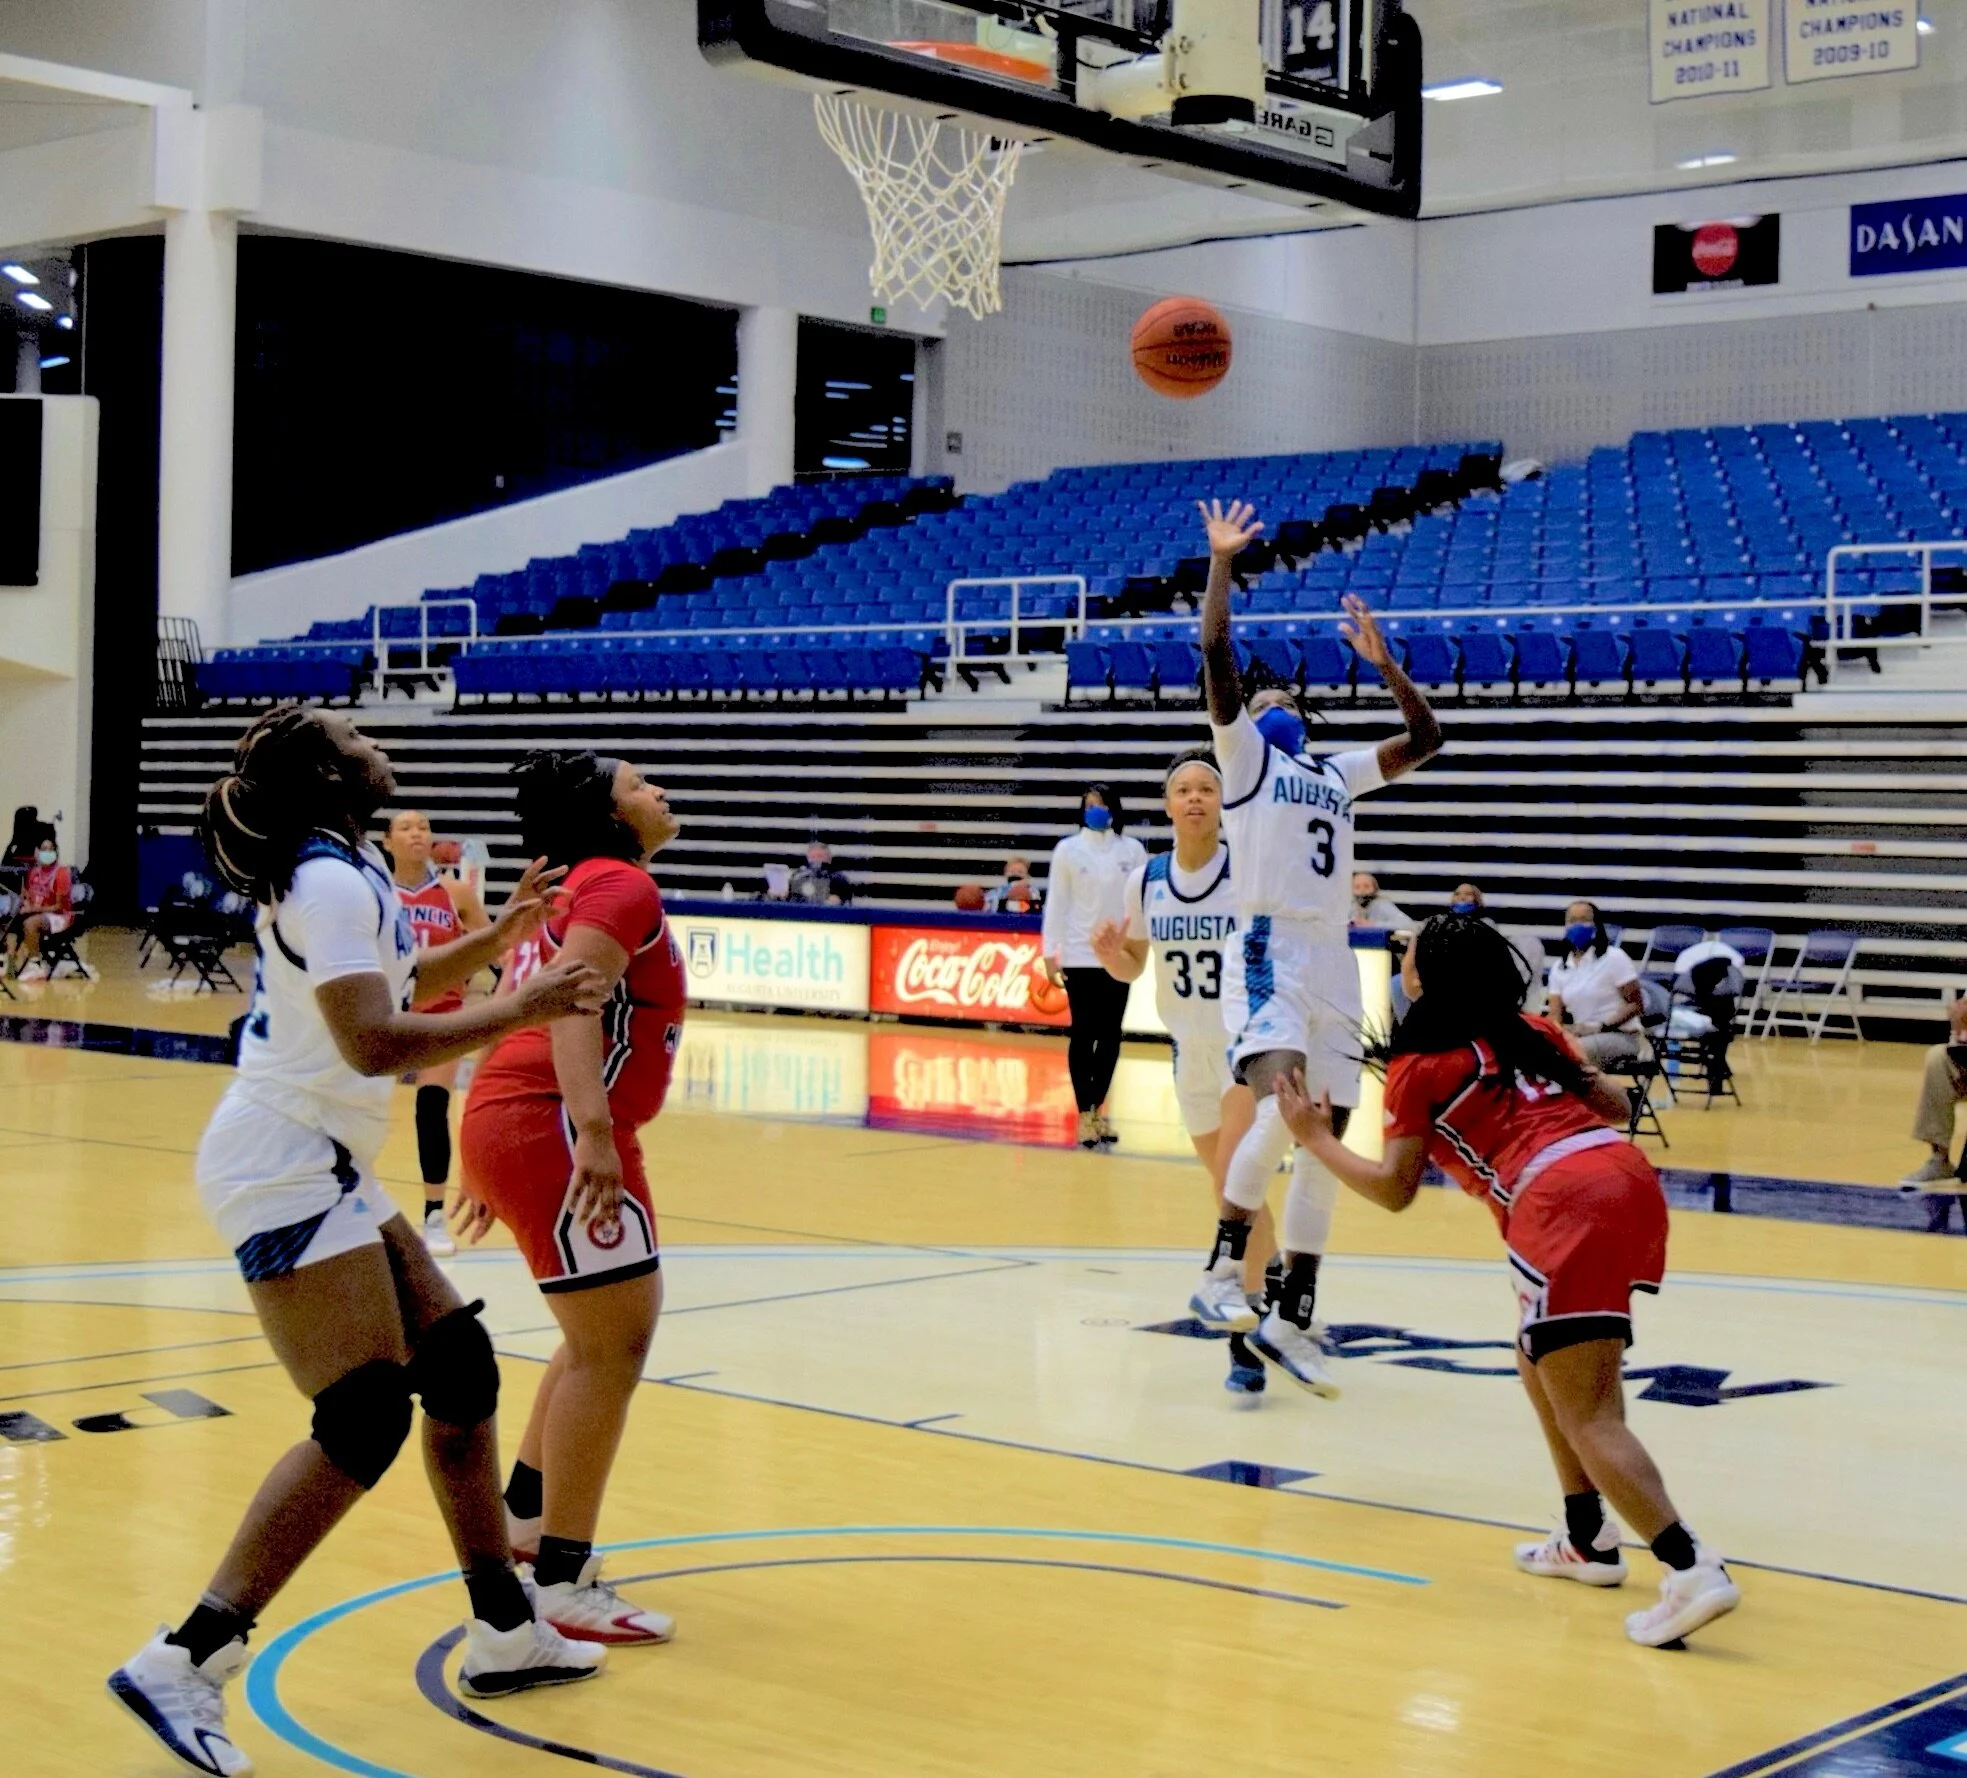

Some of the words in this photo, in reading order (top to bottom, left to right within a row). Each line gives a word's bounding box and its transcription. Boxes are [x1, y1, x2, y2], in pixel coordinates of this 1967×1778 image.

[1287, 0, 1337, 56] 14
[1667, 1, 1750, 27] NATIONAL
[1800, 9, 1904, 40] CHAMPIONS
[1662, 29, 1757, 58] CHAMPIONS
[1813, 40, 1890, 66] 2009-10
[1674, 60, 1740, 85] 2010-11
[1306, 818, 1336, 878] 3
[1150, 914, 1237, 942] AUGUSTA
[725, 931, 844, 982] Health
[1164, 949, 1223, 1000] 33
